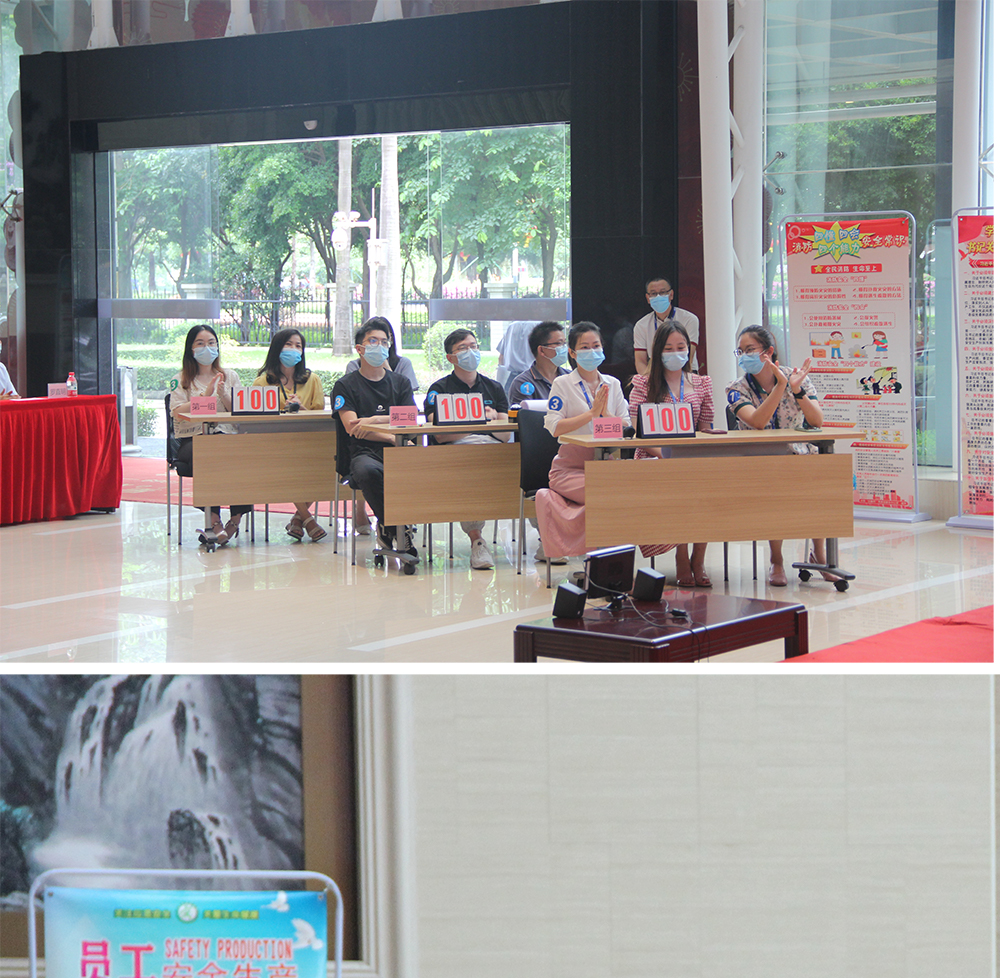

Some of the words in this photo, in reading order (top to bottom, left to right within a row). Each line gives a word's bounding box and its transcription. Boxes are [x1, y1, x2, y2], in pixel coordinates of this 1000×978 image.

[818, 241, 860, 256] 四个能力
[237, 389, 277, 410] 100
[441, 396, 482, 420] 100
[595, 423, 621, 434] 第三组
[645, 406, 692, 432] 100
[165, 938, 210, 959] SAFETY
[217, 938, 293, 960] PRODUCTION
